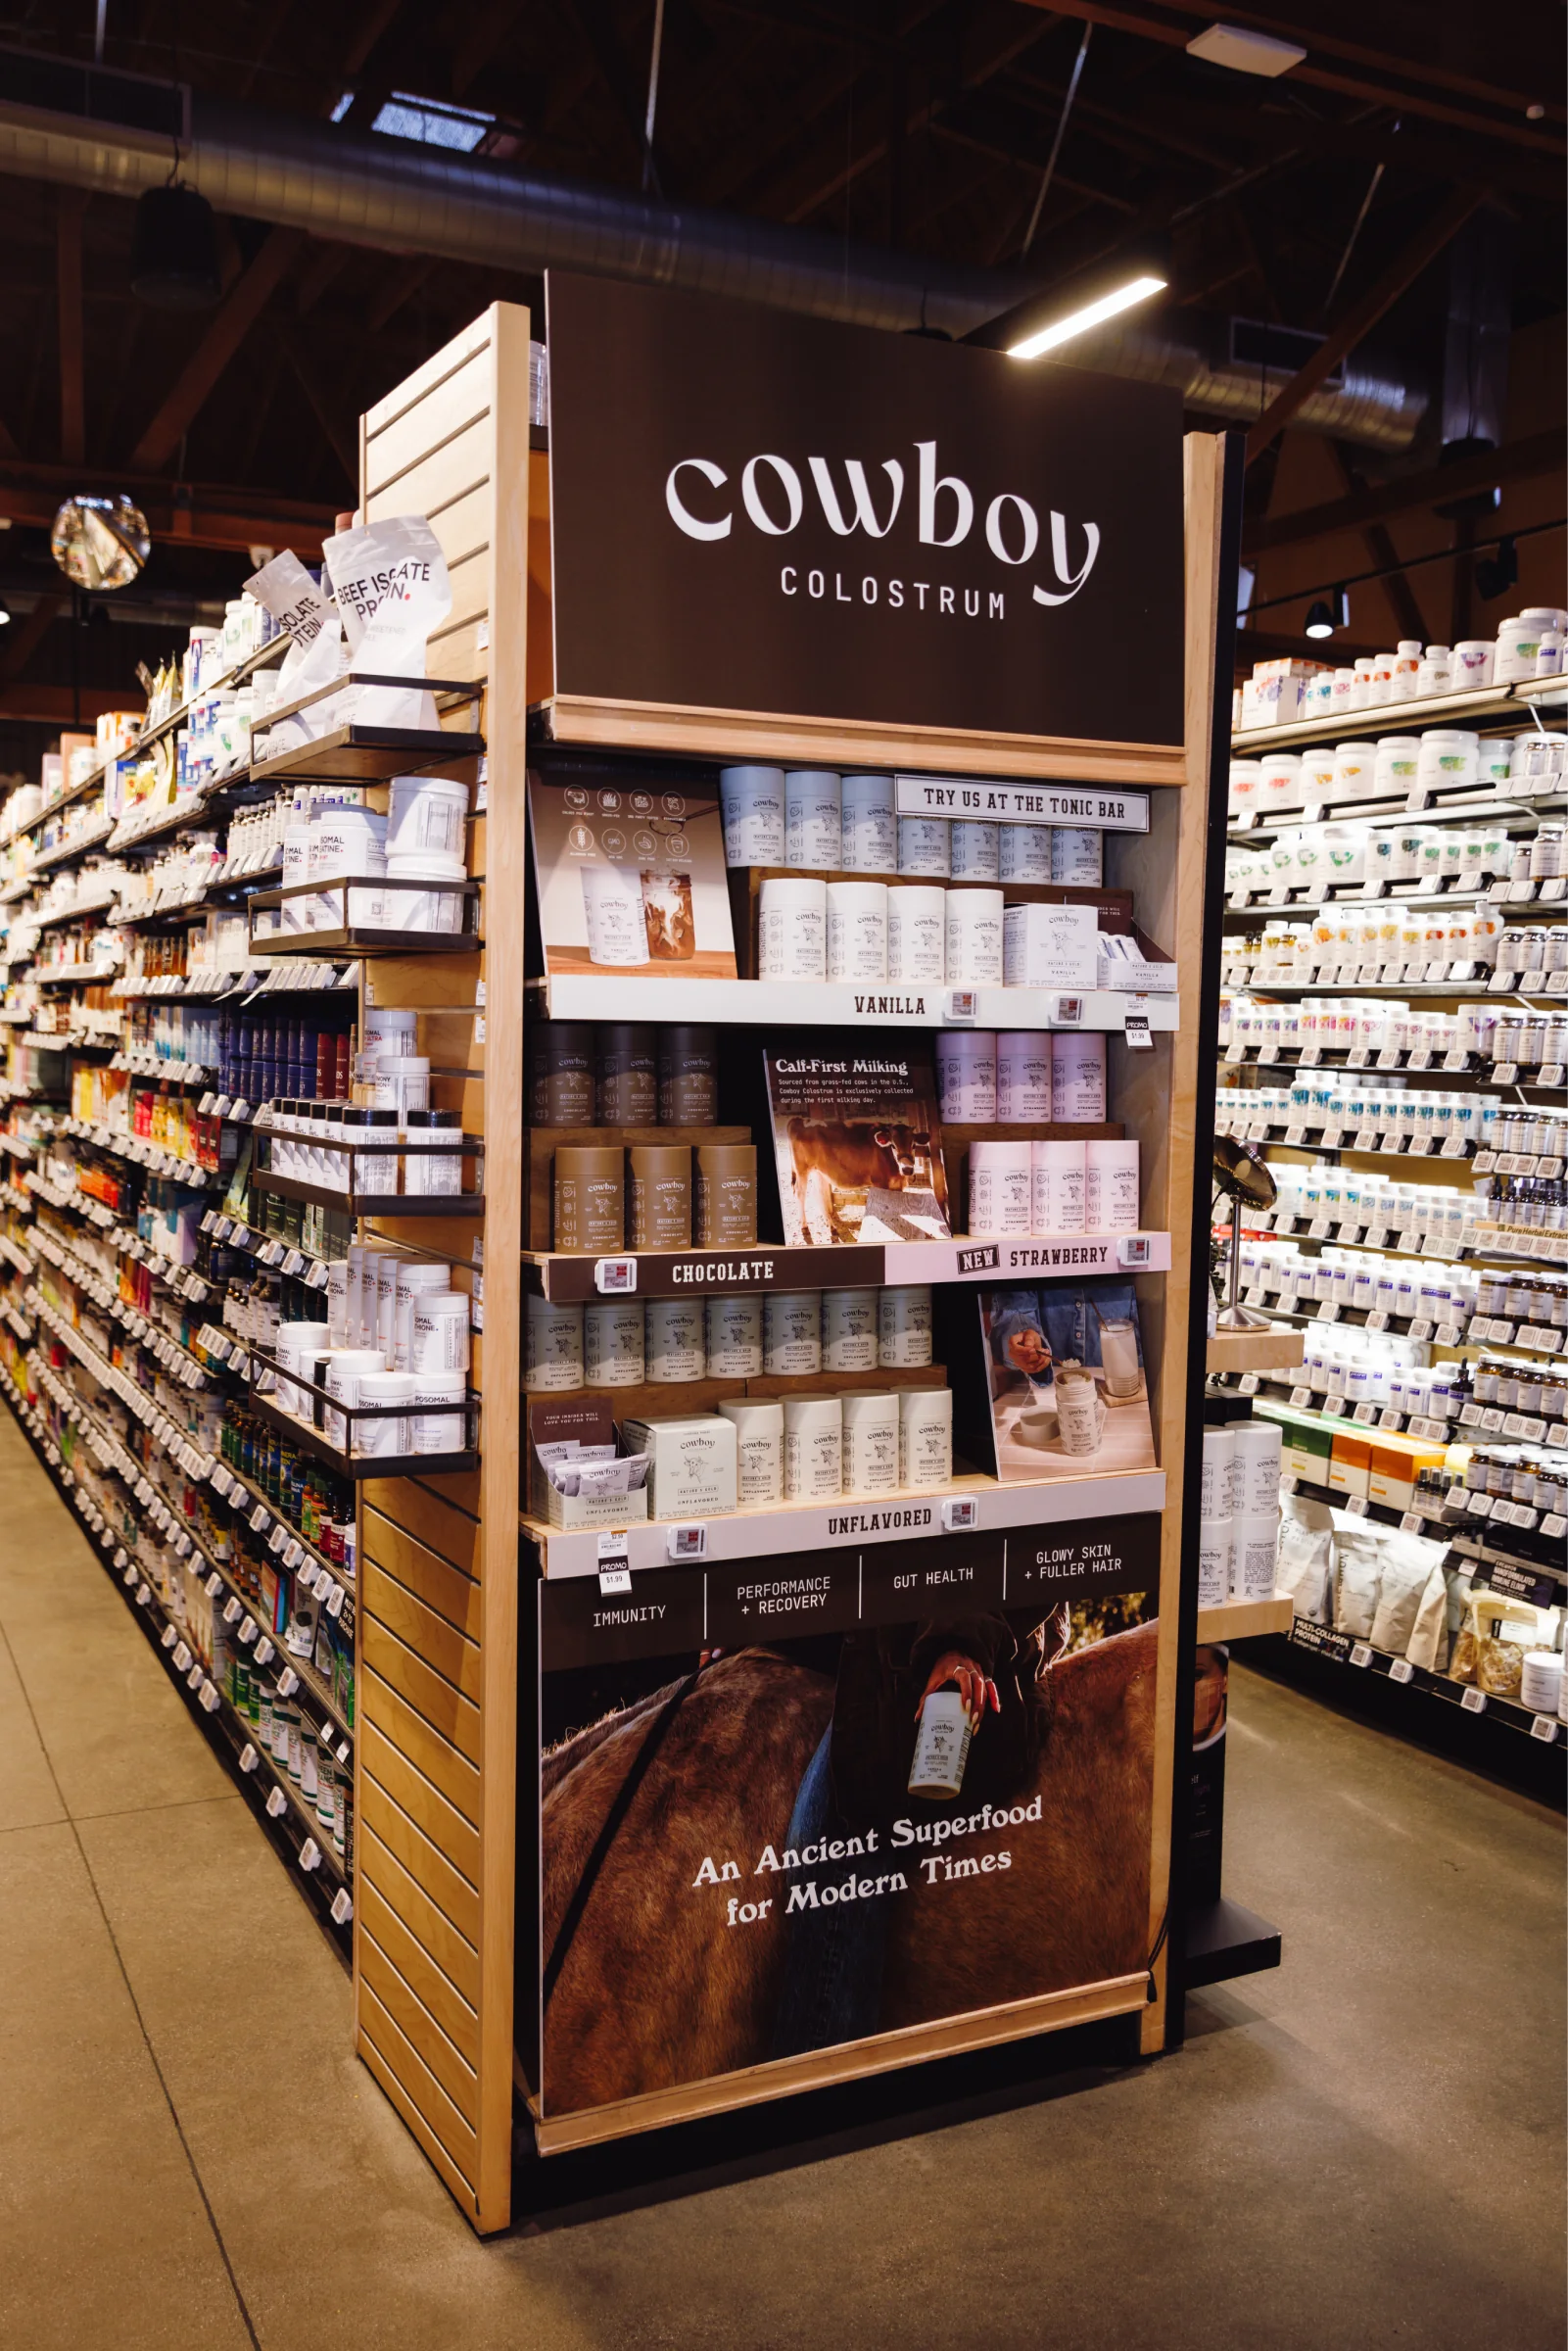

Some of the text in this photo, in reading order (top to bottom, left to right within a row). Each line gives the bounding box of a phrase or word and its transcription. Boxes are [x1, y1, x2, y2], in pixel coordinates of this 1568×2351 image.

[665, 440, 1100, 606] cowboy
[338, 580, 367, 604] BEEF
[780, 566, 1007, 620] COLOSTRUM
[753, 798, 780, 810] cowboy
[816, 803, 838, 814] cowboy
[925, 788, 1124, 819] TRY US AT THE TONIC BAR
[868, 808, 893, 818] cowboy
[600, 899, 629, 910] cowboy
[796, 912, 822, 924] cowboy
[858, 916, 882, 927] cowboy
[914, 918, 939, 929] cowboy
[1049, 914, 1078, 926] cowboy
[974, 921, 999, 931] cowboy
[854, 996, 926, 1014] VANILLA
[558, 1057, 588, 1068] cowboy
[631, 1058, 654, 1068] cowboy
[683, 1058, 711, 1068] cowboy
[776, 1059, 908, 1076] Calf-First Milking
[1022, 1061, 1047, 1071] cowboy
[1076, 1061, 1101, 1071] cowboy
[1005, 1171, 1028, 1182] cowboy
[1063, 1171, 1083, 1180] cowboy
[1114, 1171, 1137, 1179] cowboy
[588, 1180, 617, 1193] cowboy
[655, 1180, 685, 1192] cowboy
[721, 1178, 750, 1190] cowboy
[964, 1249, 994, 1271] NEW
[1011, 1246, 1108, 1267] STRAWBERRY
[672, 1261, 774, 1283] CHOCOLATE
[841, 1309, 870, 1319] cowboy
[907, 1304, 929, 1314] cowboy
[666, 1316, 694, 1326] cowboy
[724, 1313, 752, 1323] cowboy
[784, 1311, 813, 1321] cowboy
[547, 1322, 577, 1334] cowboy
[613, 1319, 640, 1331] cowboy
[868, 1430, 893, 1440] cowboy
[919, 1424, 945, 1434] cowboy
[680, 1438, 715, 1450] cowboy
[741, 1439, 771, 1450] cowboy
[814, 1433, 838, 1445] cowboy
[543, 1447, 567, 1457] cowbo
[1258, 1459, 1279, 1467] cowboy
[590, 1468, 621, 1478] cowboy
[586, 1507, 629, 1515] UNFLAVORED
[829, 1508, 931, 1535] UNFLAVORED
[1036, 1544, 1112, 1564] GLOWY SKIN
[600, 1560, 627, 1571] PROMO
[1024, 1559, 1121, 1580] + FULLER HAIR
[893, 1568, 974, 1589] GUT HEALTH
[736, 1576, 831, 1600] PERFORMANCE
[741, 1593, 827, 1614] + RECOVERY
[594, 1605, 666, 1627] IMMUNITY
[1295, 1628, 1321, 1644] PROTEIN
[1297, 1620, 1349, 1648] MULTI-COLLAGEN
[931, 1723, 954, 1733] cowboy
[692, 1795, 1043, 1887] An Ancient Superfood
[726, 1851, 1012, 1927] for Modern Times
